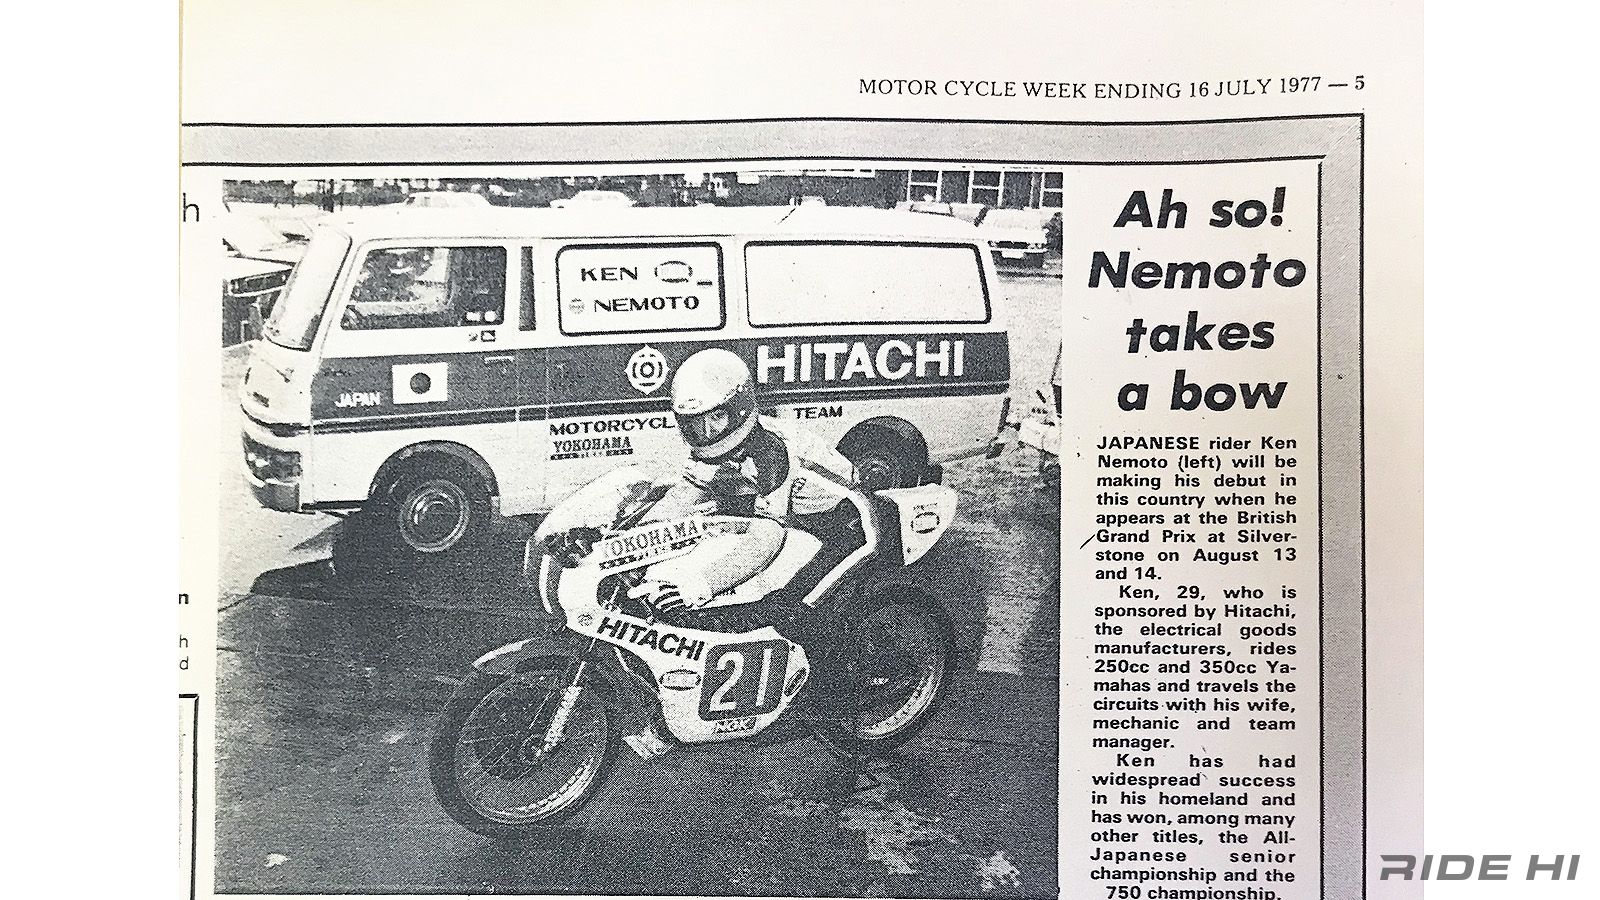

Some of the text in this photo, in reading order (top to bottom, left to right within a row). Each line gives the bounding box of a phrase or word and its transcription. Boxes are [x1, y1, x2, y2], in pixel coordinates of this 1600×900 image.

[860, 79, 937, 95] MOTOR
[945, 80, 1016, 96] CYCLE
[1023, 82, 1086, 98] WEEK
[1095, 83, 1180, 98] ENDING
[1190, 82, 1208, 97] 16
[1215, 79, 1271, 96] JULY
[1281, 77, 1321, 93] 1977
[1355, 75, 1364, 89] 5
[1113, 187, 1286, 228] Ah so!
[580, 266, 638, 281] KEN
[1088, 251, 1306, 289] Nemoto
[594, 296, 699, 312] NEMOTO
[1126, 311, 1274, 353] takes
[756, 339, 965, 384] HITACHI
[1118, 369, 1288, 411] a bow
[334, 392, 380, 408] JAPAN
[549, 405, 843, 436] MOTORCYCL TEAM
[552, 436, 632, 454] YOKOHAMA
[1097, 436, 1296, 450] JAPANESE rider Ken
[1098, 455, 1296, 472] Nemoto (left) will be
[1097, 473, 1296, 490] making his debut in
[1097, 492, 1296, 508] this country when he
[1096, 511, 1296, 527] appears at the British
[1097, 529, 1297, 543] Grand Prix at Silver-
[1096, 548, 1296, 565] stone on August 13
[1096, 567, 1161, 580] and 14.
[1120, 585, 1296, 600] Ken, 29, who is
[1095, 604, 1295, 620] sponsored by Hitachi,
[597, 616, 705, 661] HITACHI
[1095, 622, 1296, 640] the electrical goods
[1095, 641, 1296, 656] manufacturers, rides
[1095, 659, 1296, 674] 250cc and 350cc Ya-
[708, 648, 773, 712] 21
[1094, 679, 1296, 692] mahas and travels the
[1094, 697, 1295, 713] circuits with his wife,
[1093, 716, 1295, 730] mechanic and team
[1093, 738, 1174, 751] manager.
[1117, 754, 1295, 768] Ken has had
[1092, 772, 1295, 789] widespread success
[1092, 791, 1295, 806] in his homeland and
[1092, 810, 1295, 828] has won, among many
[1091, 829, 1295, 845] other titles, the All-
[1090, 848, 1296, 864] Japanese senior
[1091, 866, 1295, 884] championship and the
[1106, 886, 1141, 899] 750
